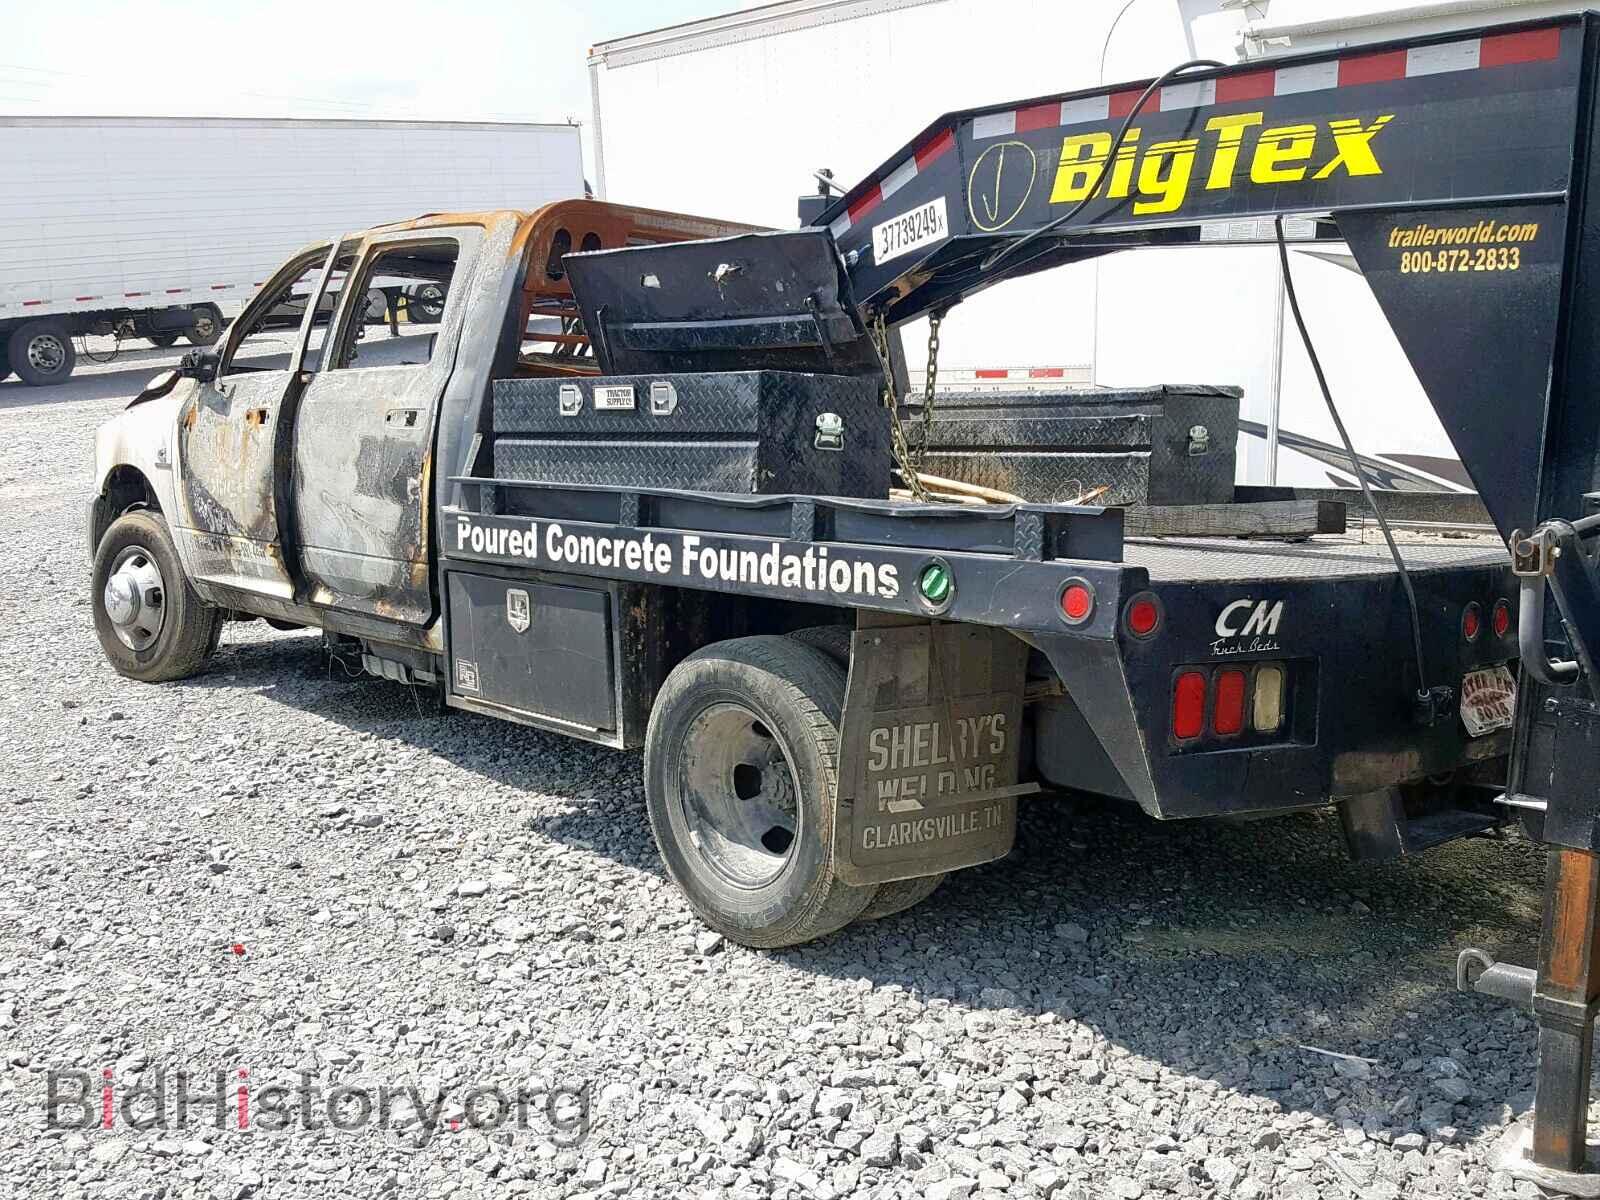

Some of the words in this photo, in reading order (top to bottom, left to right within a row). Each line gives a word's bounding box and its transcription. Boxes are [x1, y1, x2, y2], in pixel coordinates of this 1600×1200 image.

[881, 205, 937, 254] 37739249
[1388, 219, 1538, 247] trailerworld.com
[1400, 247, 1520, 273] 800-872-2833
[457, 515, 538, 559] Poured
[546, 524, 672, 574] Concrete
[682, 535, 899, 599] Foundations
[1215, 598, 1284, 637] CM
[877, 763, 996, 812] WELDNG
